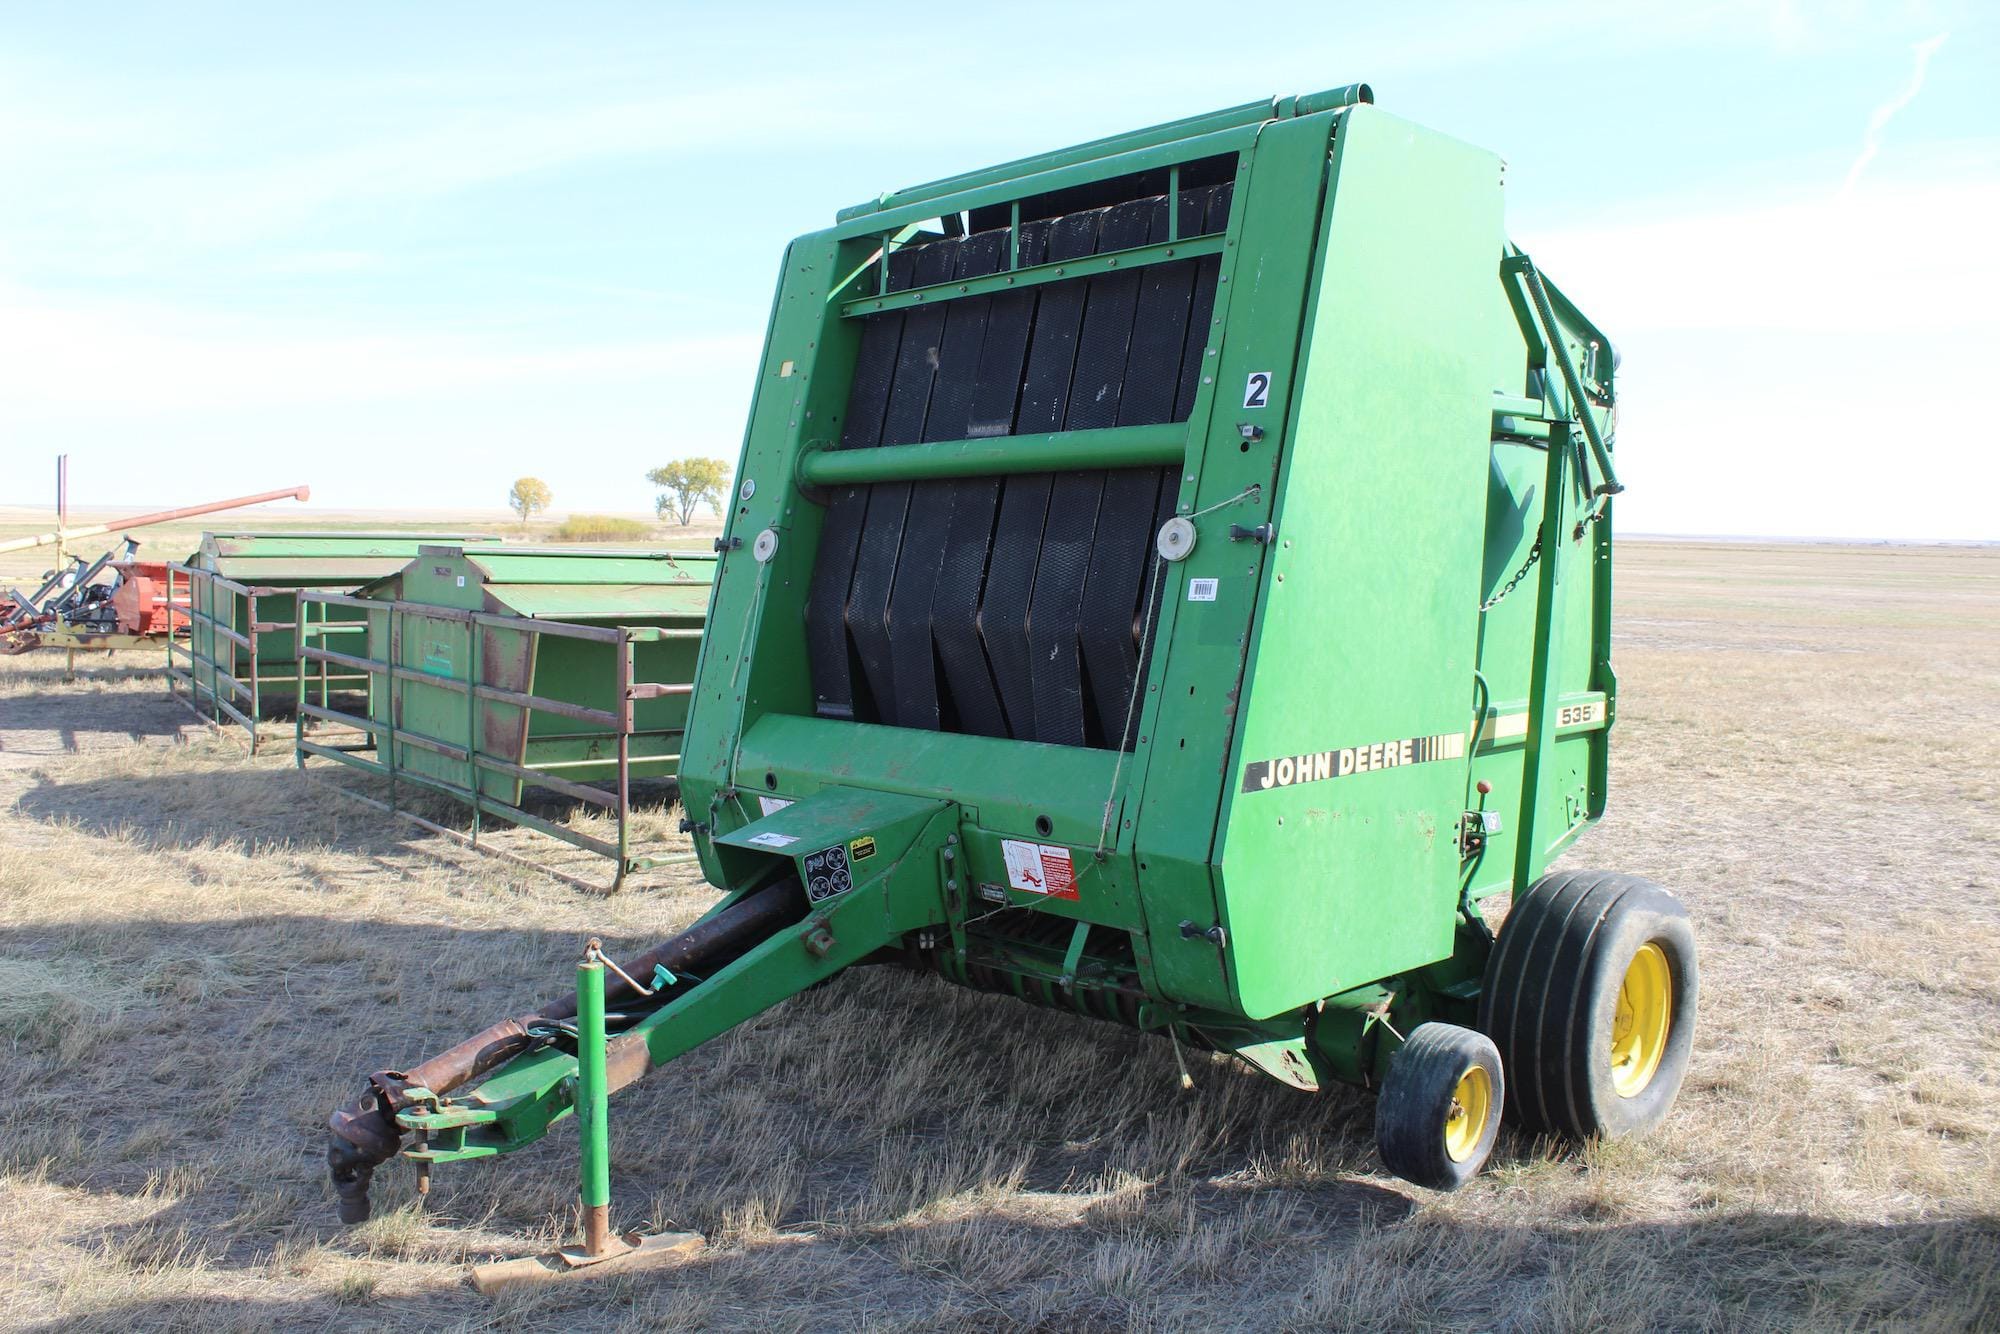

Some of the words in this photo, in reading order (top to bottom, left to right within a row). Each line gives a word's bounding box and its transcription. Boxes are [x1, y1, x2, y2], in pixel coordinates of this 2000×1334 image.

[1246, 374, 1268, 407] 2
[1562, 705, 1591, 725] 535
[1260, 751, 1331, 789] JOHN
[1338, 739, 1413, 777] DEERE
